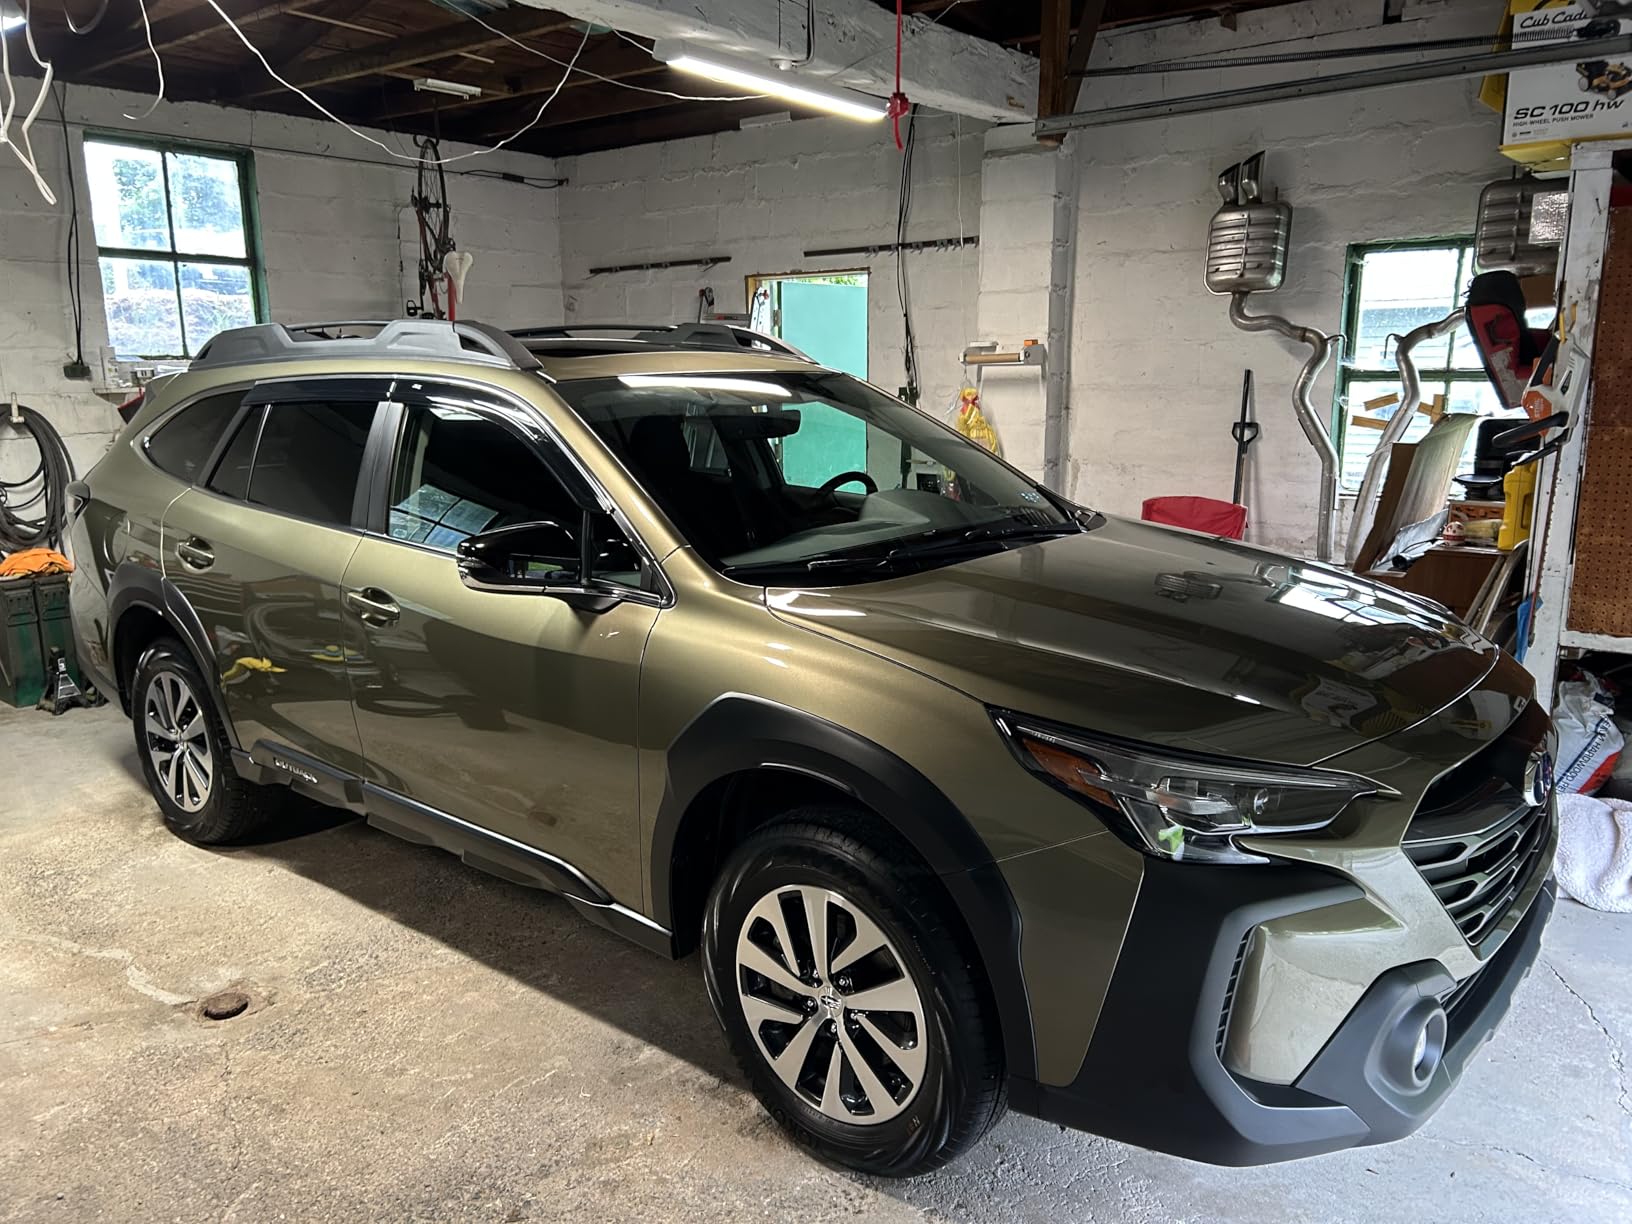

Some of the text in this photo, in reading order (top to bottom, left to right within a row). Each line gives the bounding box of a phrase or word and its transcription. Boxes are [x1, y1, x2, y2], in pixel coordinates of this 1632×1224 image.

[1520, 14, 1549, 29] Cub
[1514, 99, 1624, 120] SC 100 hw
[1570, 113, 1594, 121] MOWER
[1566, 741, 1602, 782] HARDWOOD
